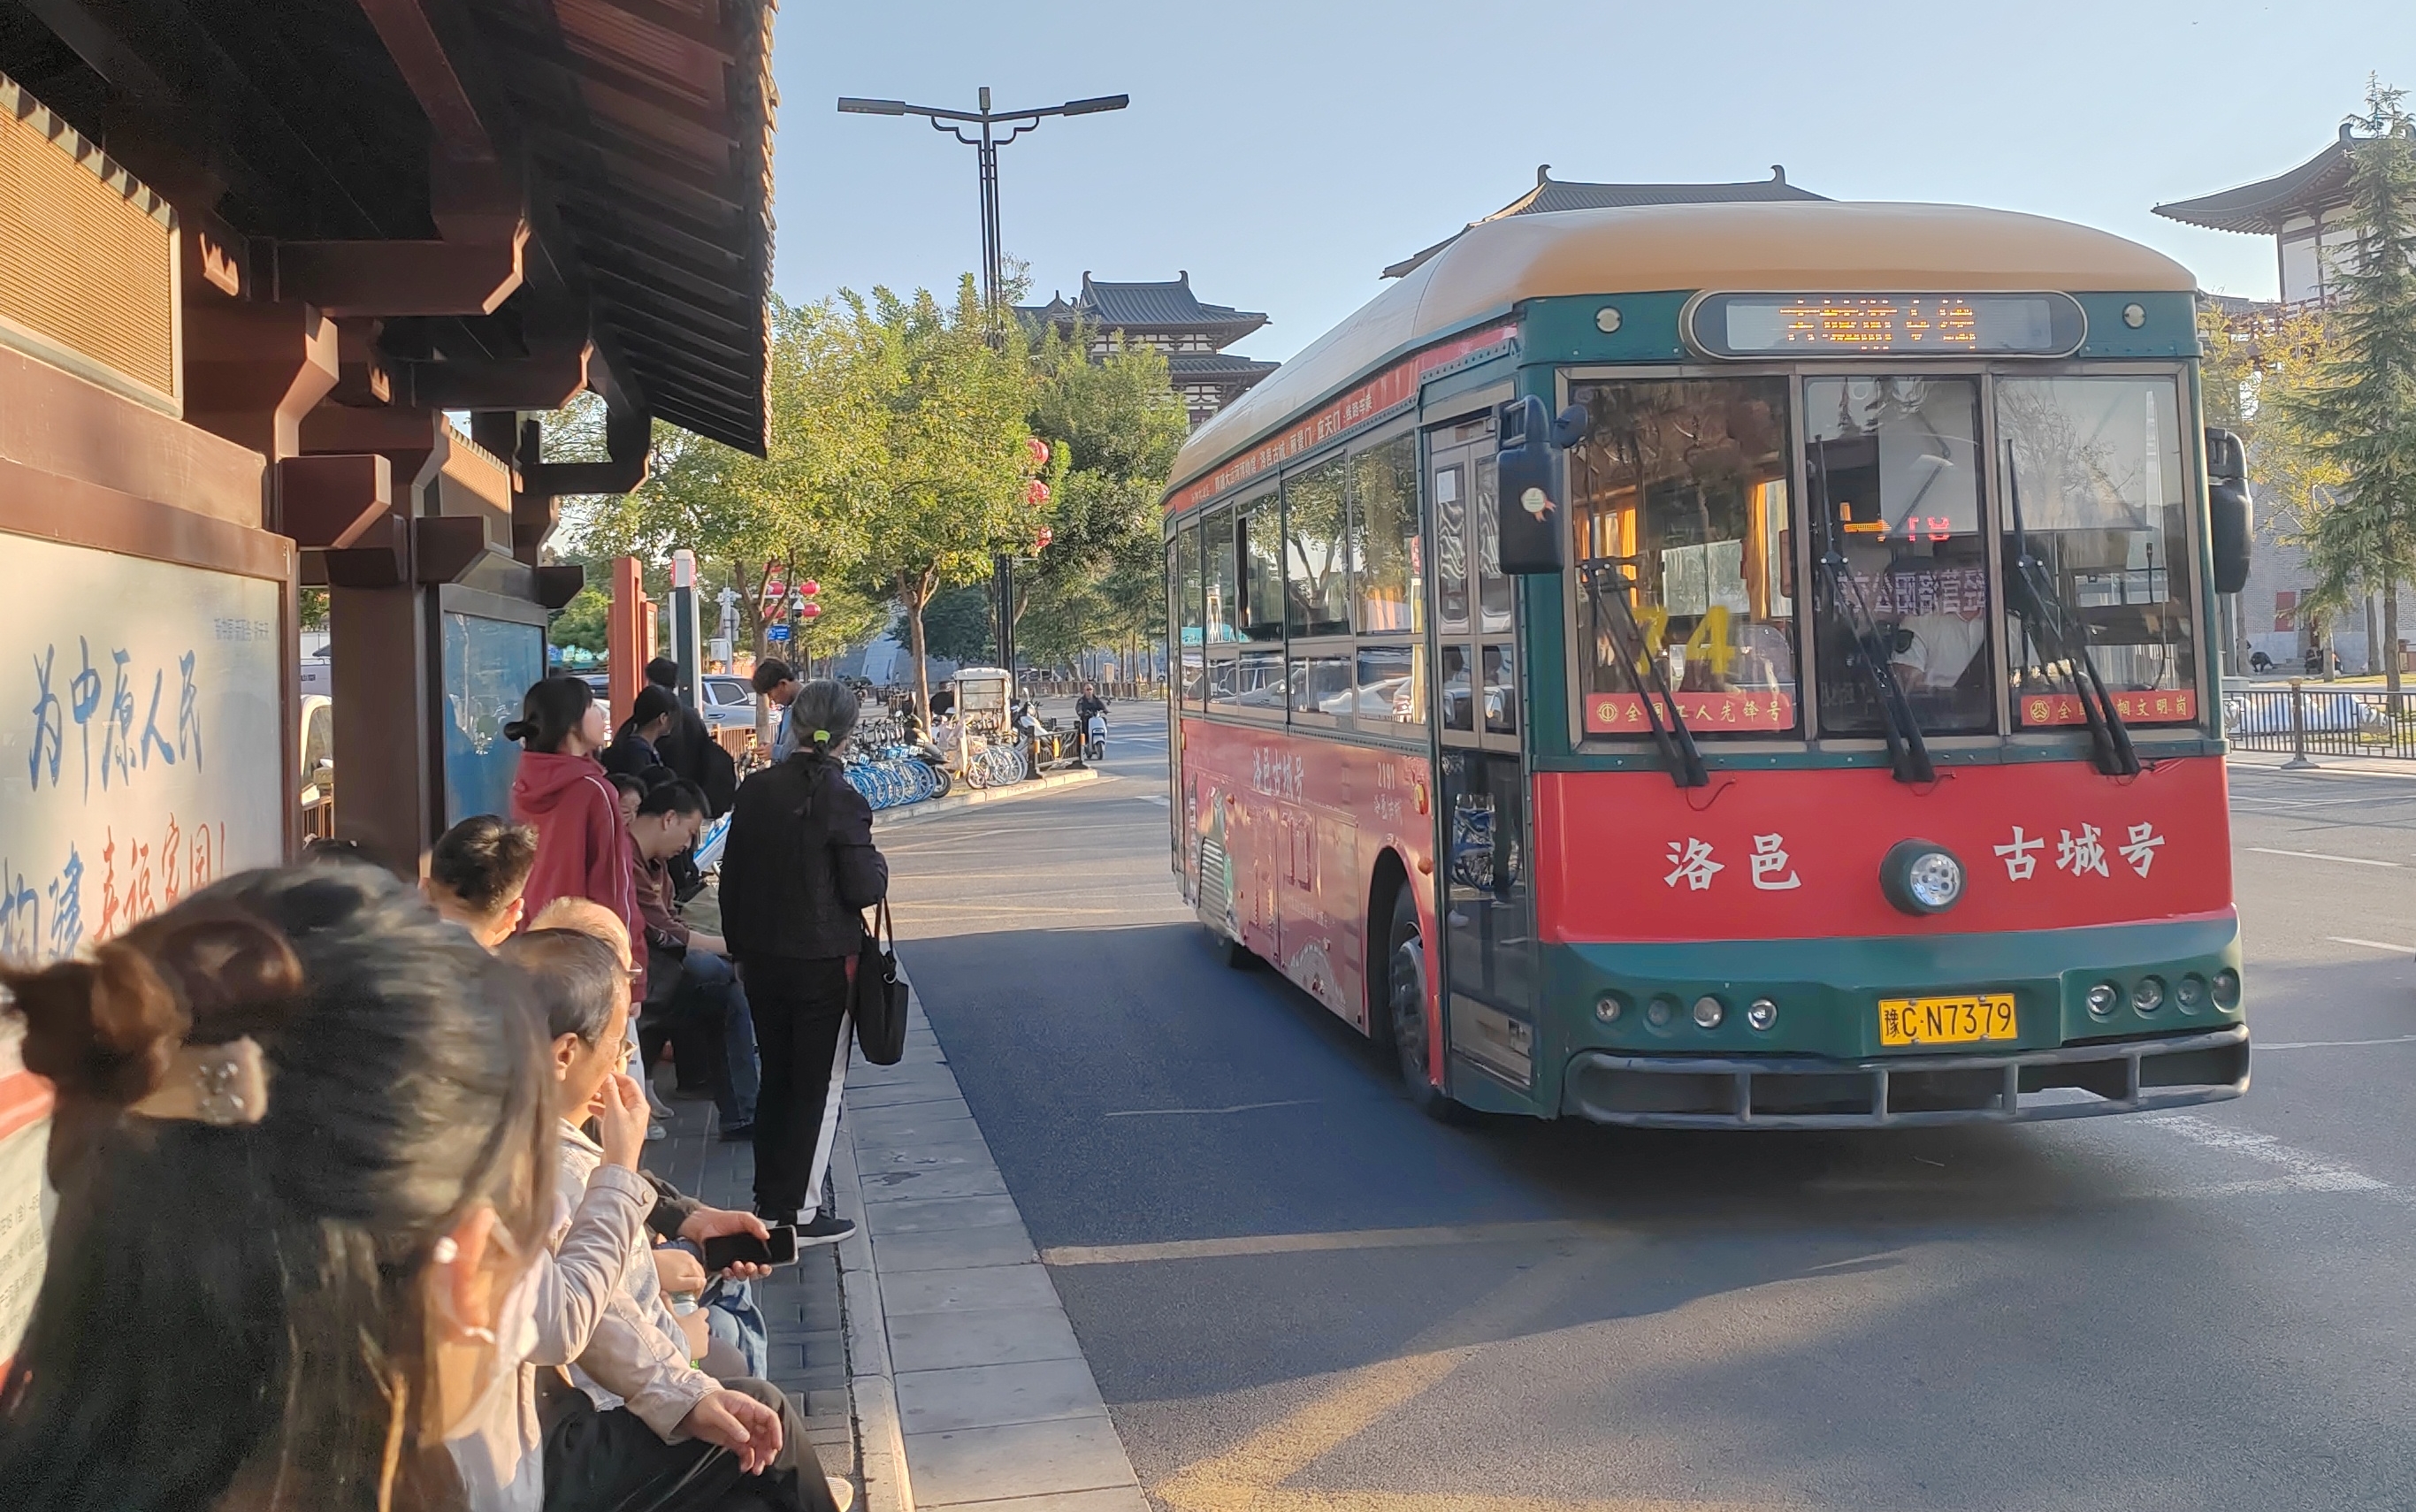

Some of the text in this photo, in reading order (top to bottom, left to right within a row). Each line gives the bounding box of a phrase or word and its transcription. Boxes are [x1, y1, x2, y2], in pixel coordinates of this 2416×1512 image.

[2057, 694, 2188, 721] 全帼文明岗
[1663, 821, 2167, 891] 洛邑 古城号
